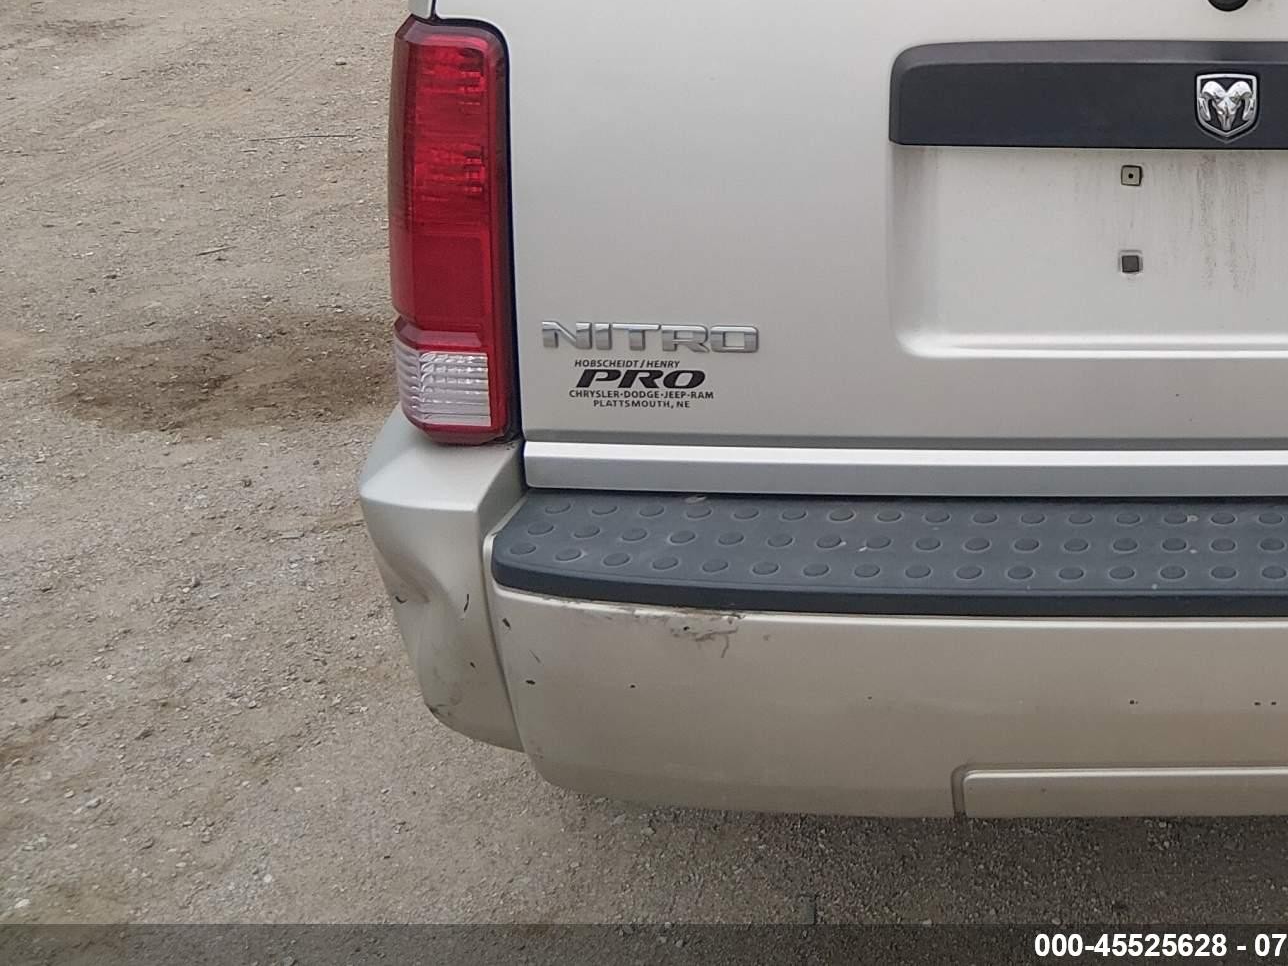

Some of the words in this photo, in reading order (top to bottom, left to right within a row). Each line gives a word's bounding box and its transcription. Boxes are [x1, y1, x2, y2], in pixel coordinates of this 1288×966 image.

[541, 321, 759, 353] NITRO
[575, 368, 706, 389] PRO
[593, 399, 674, 409] PLATTSMOUTH,
[676, 400, 691, 409] NE
